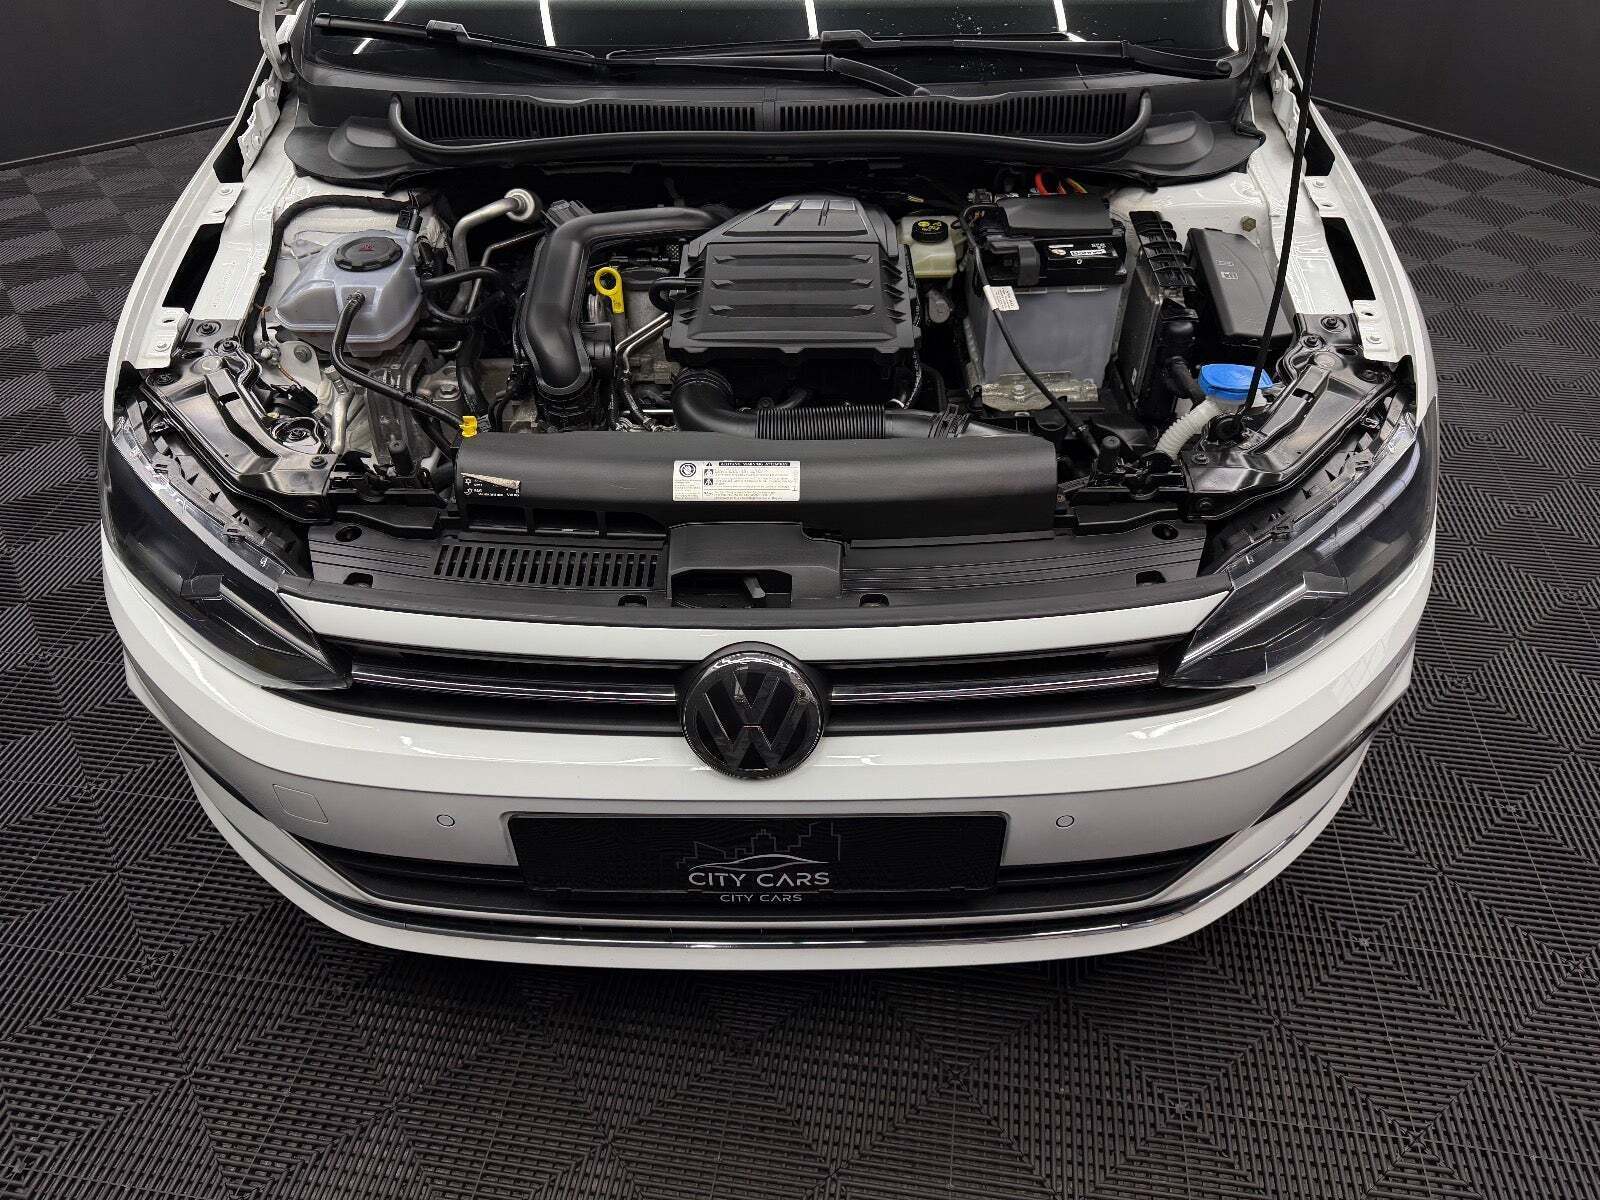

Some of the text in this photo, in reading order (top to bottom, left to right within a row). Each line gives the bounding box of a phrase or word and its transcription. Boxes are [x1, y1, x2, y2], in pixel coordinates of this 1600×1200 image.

[688, 872, 830, 887] CITY CARS
[719, 894, 803, 902] CITY CARS
